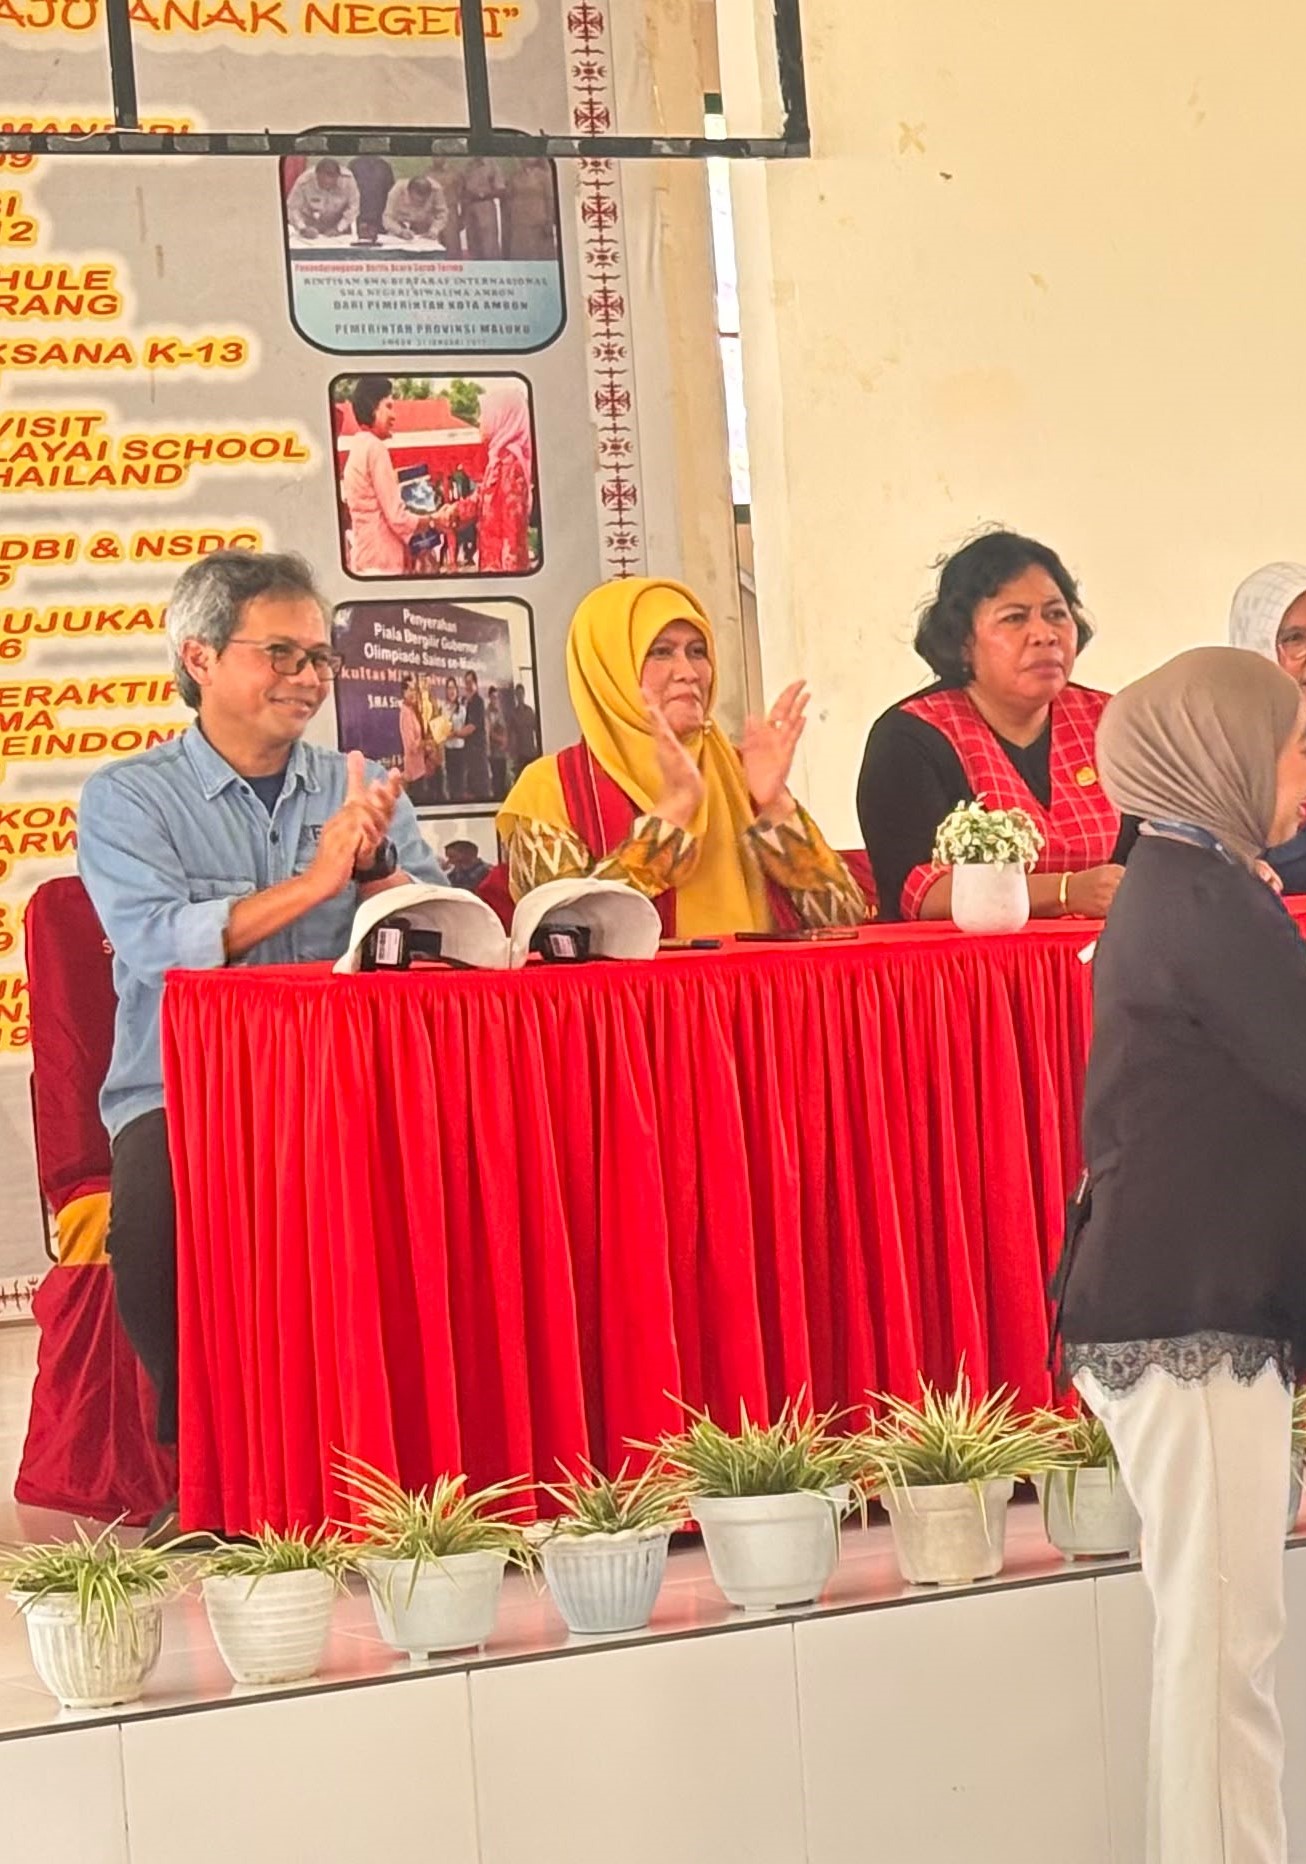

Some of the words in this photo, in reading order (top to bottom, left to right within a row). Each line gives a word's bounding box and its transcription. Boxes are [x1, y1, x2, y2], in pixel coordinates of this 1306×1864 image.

[305, 3, 519, 37] NEGEI”
[0, 343, 133, 364] SANA
[147, 342, 243, 364] K-13
[0, 441, 108, 463] AYAI
[122, 437, 306, 460] SCHOOL
[90, 537, 121, 558] &
[3, 608, 167, 634] UJUKA
[373, 622, 403, 642] Piala
[363, 642, 421, 666] Olimpiade
[422, 652, 446, 668] Sains
